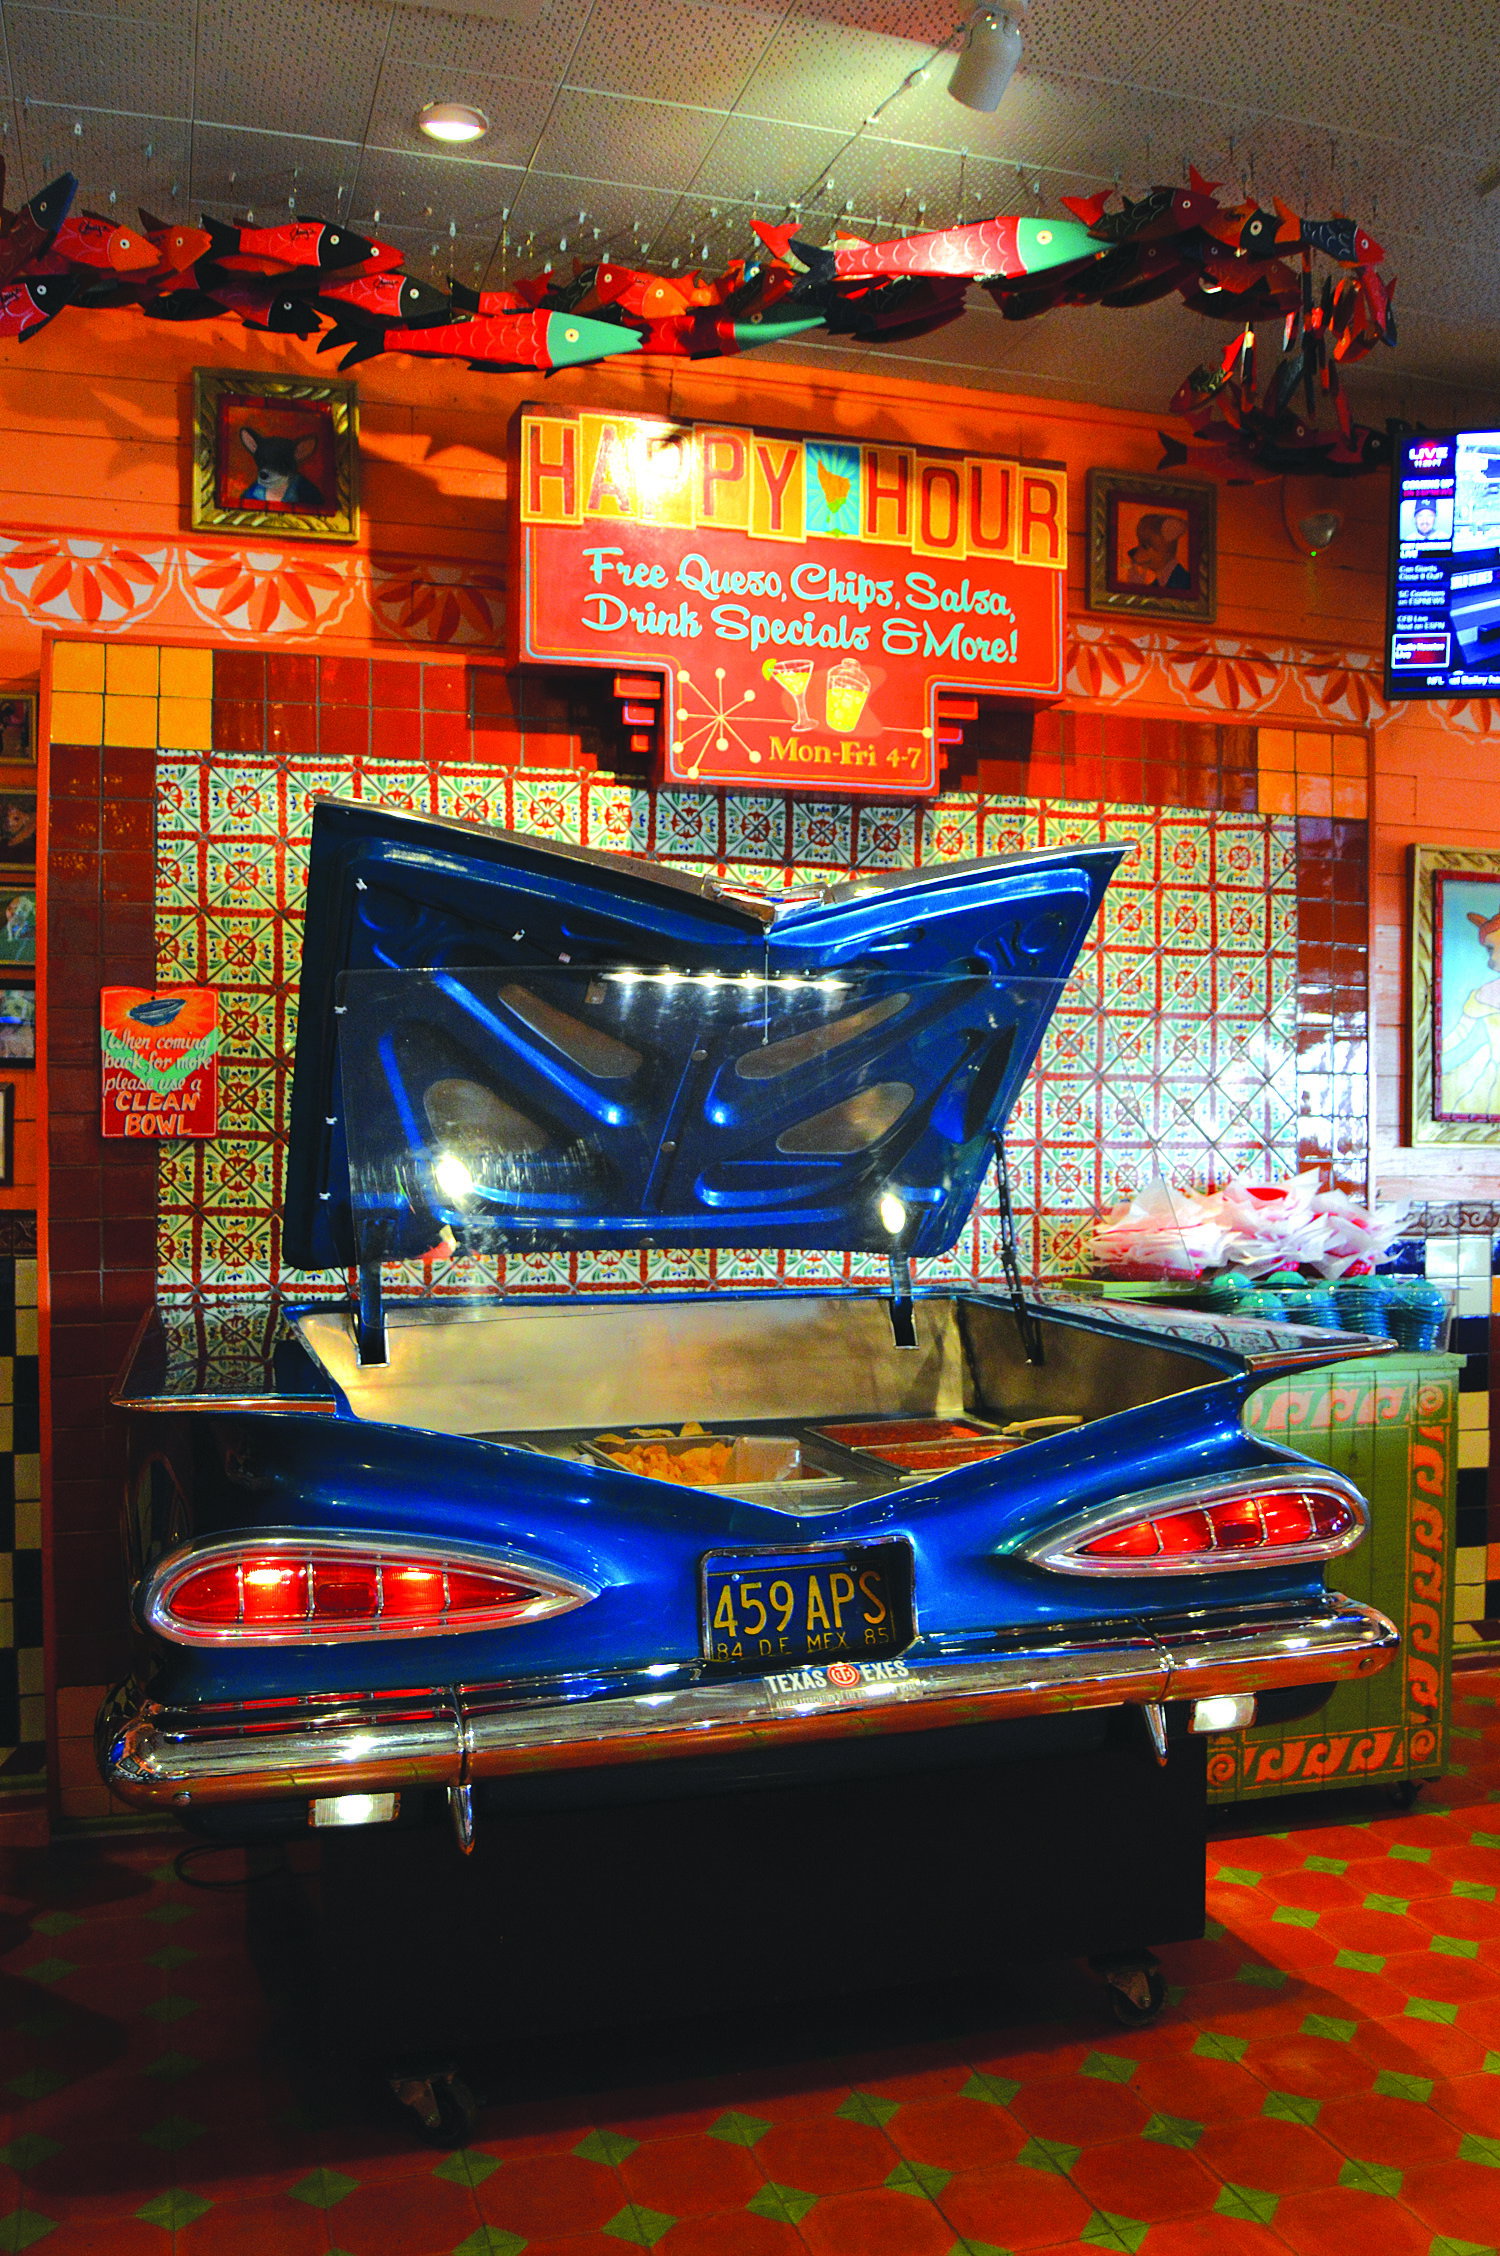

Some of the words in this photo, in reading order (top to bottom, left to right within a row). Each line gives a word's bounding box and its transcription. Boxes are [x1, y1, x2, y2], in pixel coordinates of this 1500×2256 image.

[1409, 446, 1448, 460] LIVE
[865, 445, 1061, 561] HOUR
[583, 547, 669, 589] Free
[675, 553, 787, 603] Queso,
[790, 563, 900, 613] Chips,
[905, 572, 1016, 624] Salsa,
[581, 593, 702, 638] Drink
[711, 604, 871, 652] Specials
[769, 736, 877, 767] Mon-Fri
[886, 747, 922, 770] 4-7
[103, 1027, 151, 1050] When
[155, 1035, 211, 1058] coming
[104, 1049, 144, 1070] back
[147, 1050, 173, 1073] for
[176, 1056, 212, 1071] more
[103, 1072, 155, 1096] please
[157, 1077, 186, 1092] use
[190, 1077, 202, 1092] a
[115, 1091, 200, 1112] CLEAN
[124, 1113, 193, 1136] BOWL
[764, 1669, 828, 1694] TEXAS
[858, 1660, 910, 1682] EXES
